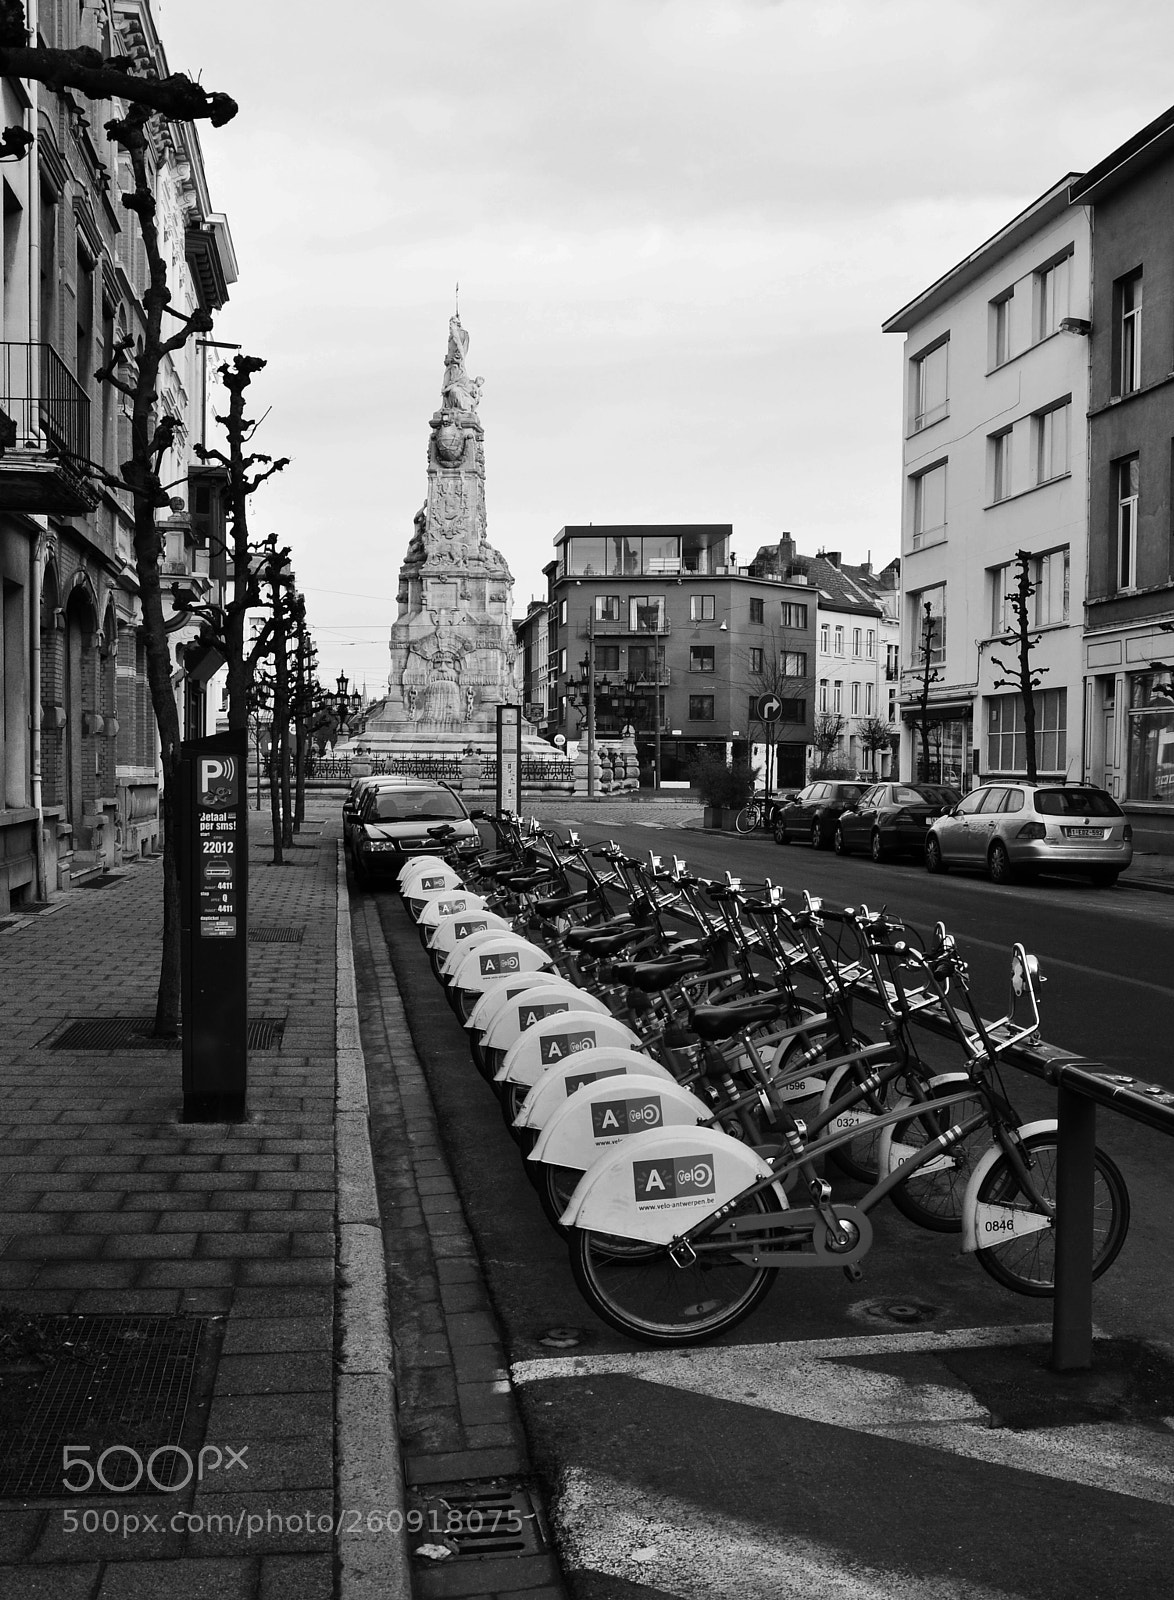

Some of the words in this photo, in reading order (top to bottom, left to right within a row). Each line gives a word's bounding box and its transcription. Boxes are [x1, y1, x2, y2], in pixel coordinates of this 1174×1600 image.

[201, 759, 223, 793] P
[200, 812, 227, 822] Betaal
[200, 822, 214, 831] per
[216, 821, 236, 831] sms!
[203, 841, 234, 854] 22012
[217, 882, 233, 890] 4411
[217, 905, 233, 913] 4411
[459, 926, 468, 936] A
[485, 959, 496, 971] A
[526, 1011, 538, 1026] A
[548, 1041, 563, 1058] A
[601, 1109, 620, 1129] A
[836, 1118, 860, 1128] 0321
[645, 1168, 666, 1192] A
[638, 1197, 715, 1211] www.velo-antwerpen.be
[984, 1220, 1014, 1232] 0846
